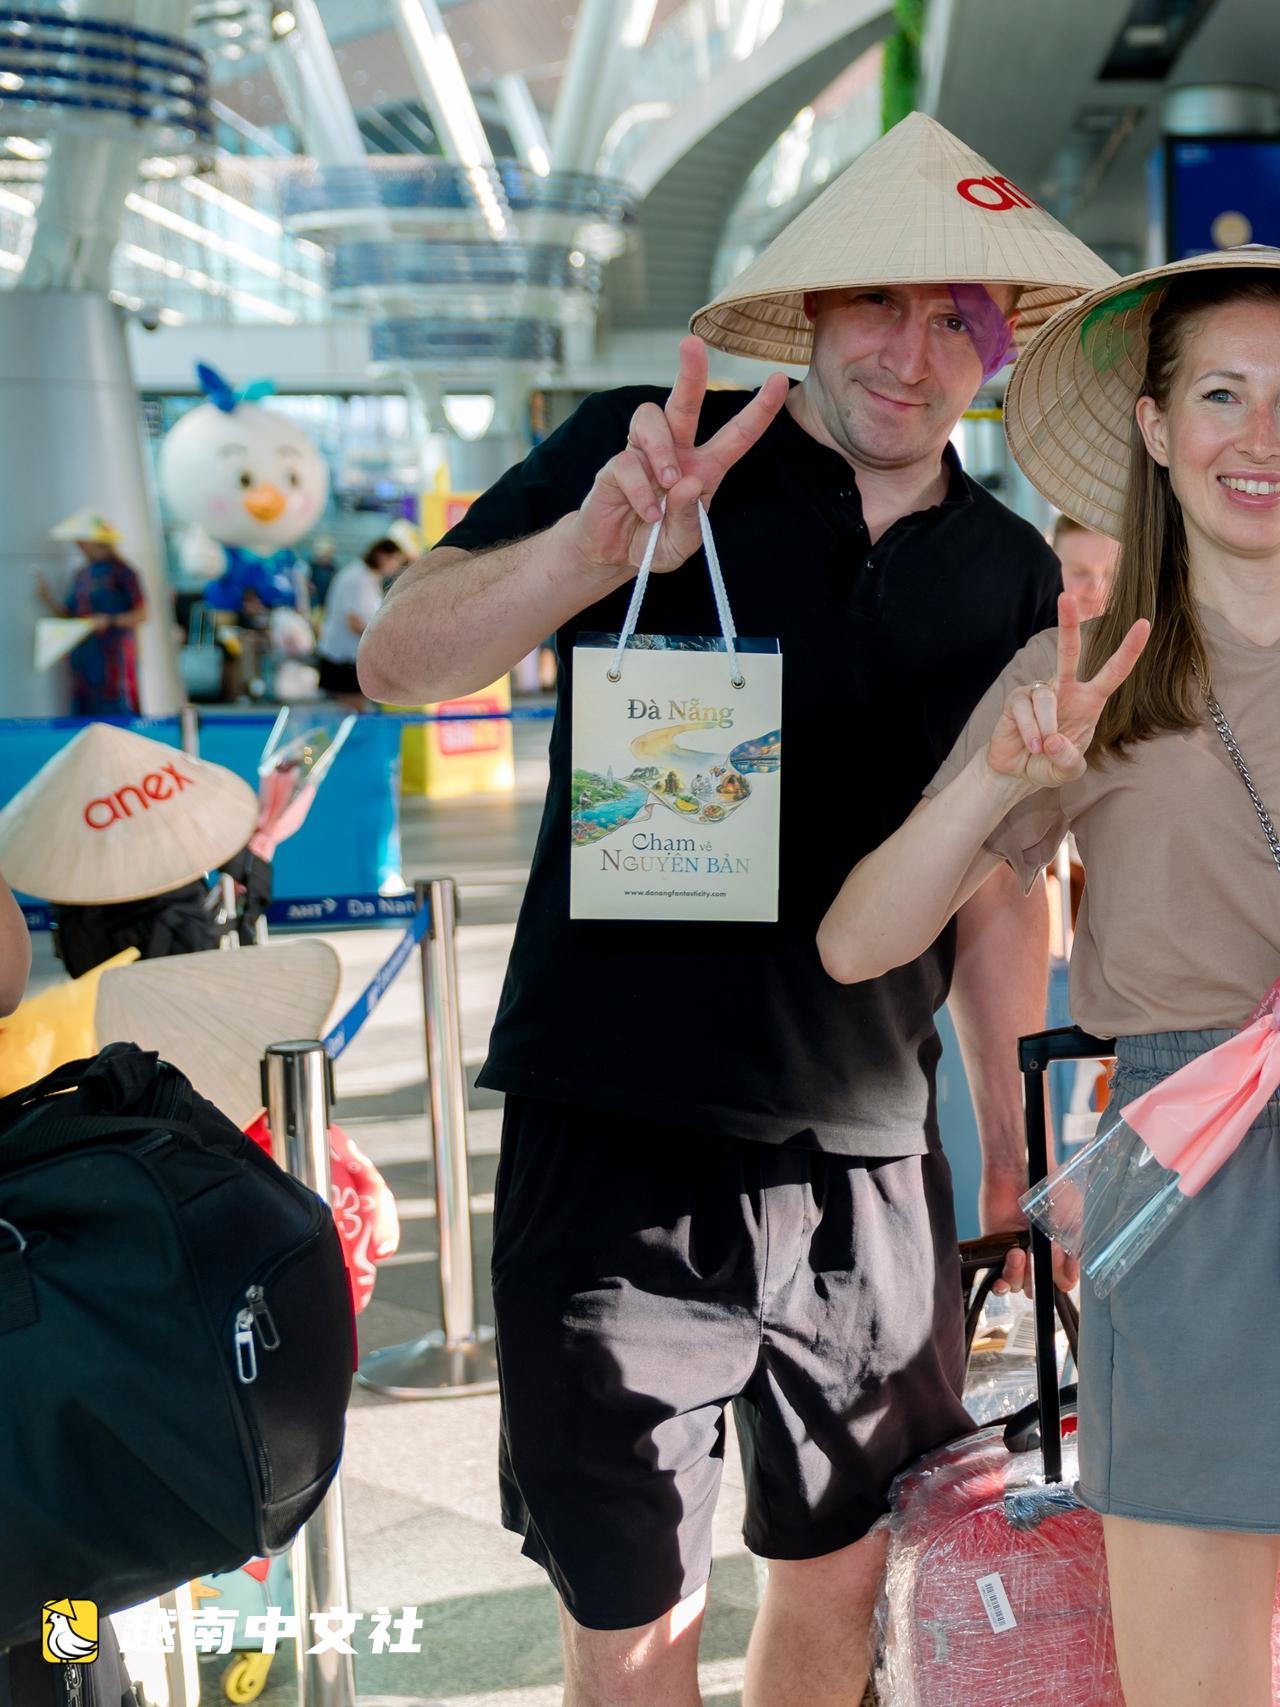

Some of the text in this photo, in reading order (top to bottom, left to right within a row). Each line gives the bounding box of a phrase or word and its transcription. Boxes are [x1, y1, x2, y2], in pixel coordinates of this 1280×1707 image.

[956, 175, 1044, 212] an
[627, 698, 734, 729] Đà Nẵng
[84, 763, 196, 830] anex
[632, 833, 696, 855] Chạm
[706, 853, 751, 874] BẢN
[347, 899, 376, 918] Da
[378, 898, 416, 914] Nan
